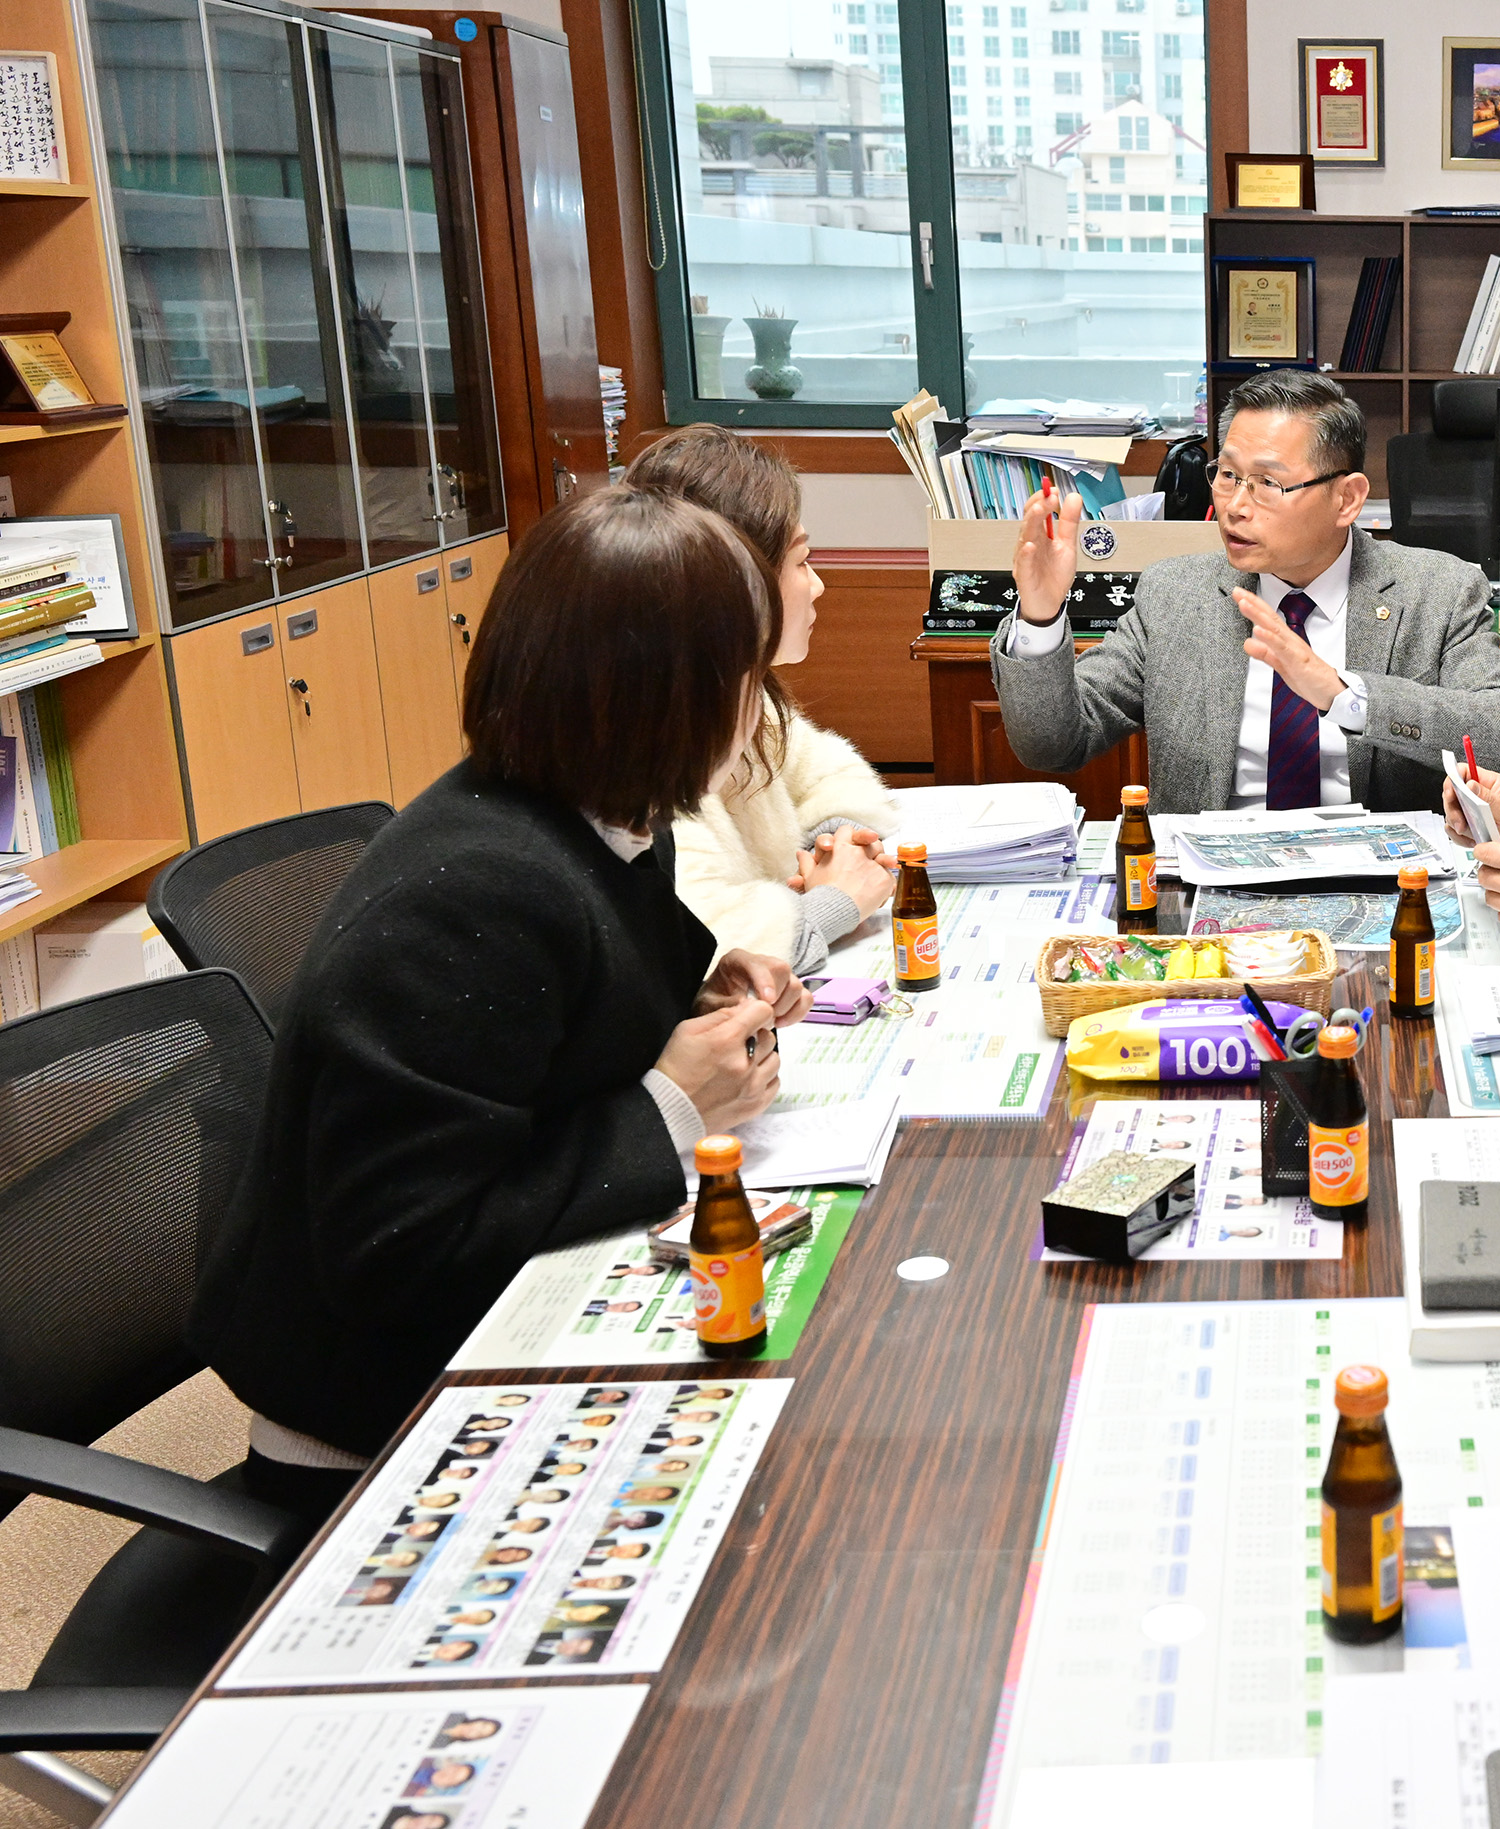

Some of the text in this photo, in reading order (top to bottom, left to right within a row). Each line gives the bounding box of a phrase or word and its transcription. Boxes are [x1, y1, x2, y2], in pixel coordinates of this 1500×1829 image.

[1170, 1036, 1247, 1076] 100
[1313, 1157, 1353, 1172] 비타500
[1458, 1185, 1479, 1207] 2024
[696, 1287, 718, 1301] 500
